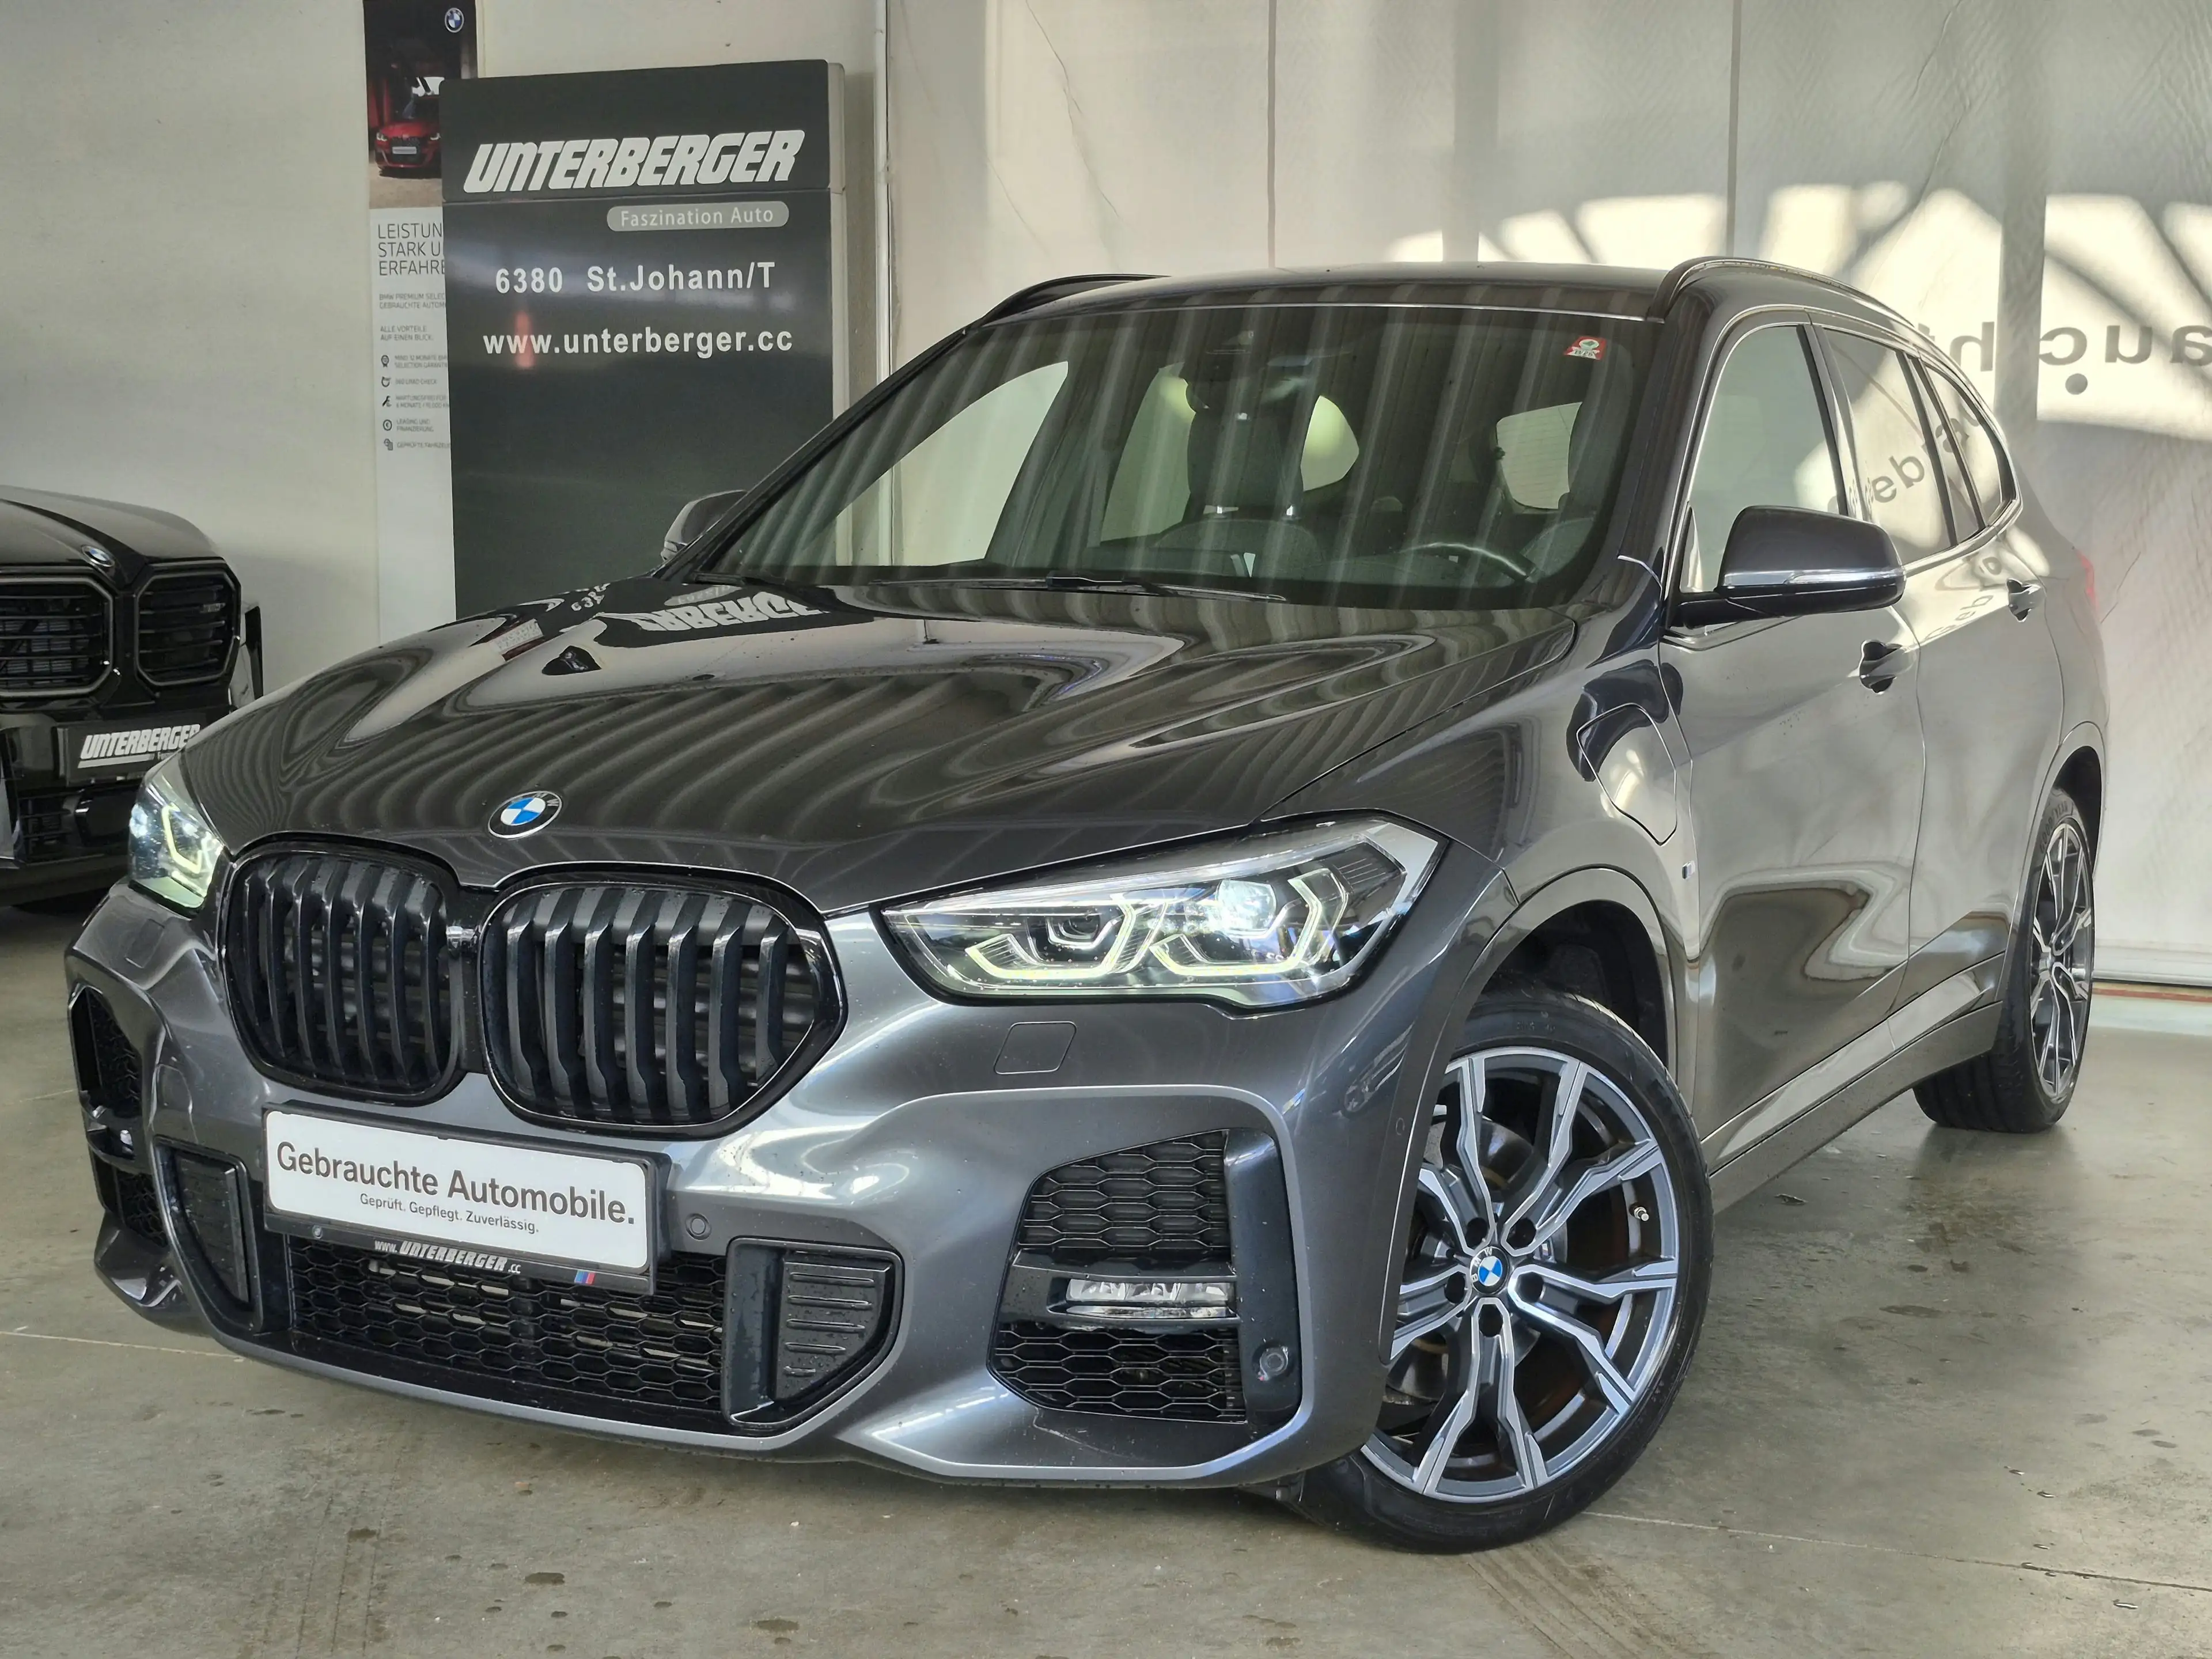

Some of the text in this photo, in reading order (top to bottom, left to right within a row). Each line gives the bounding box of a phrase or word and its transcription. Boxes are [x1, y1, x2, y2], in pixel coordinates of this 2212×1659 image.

[463, 130, 805, 193] UNTERBERGER
[621, 206, 774, 227] Faszination Auto
[378, 242, 426, 257] STARK
[495, 262, 775, 293] 6380 St.Johann/T
[483, 327, 793, 358] www.unterberger.cc
[276, 1141, 634, 1225] Gebrauchte Automobile.
[360, 1194, 539, 1234] Geprüft. Gepflegt. Zuverlässig.
[400, 1240, 507, 1272] UNTERBERGER
